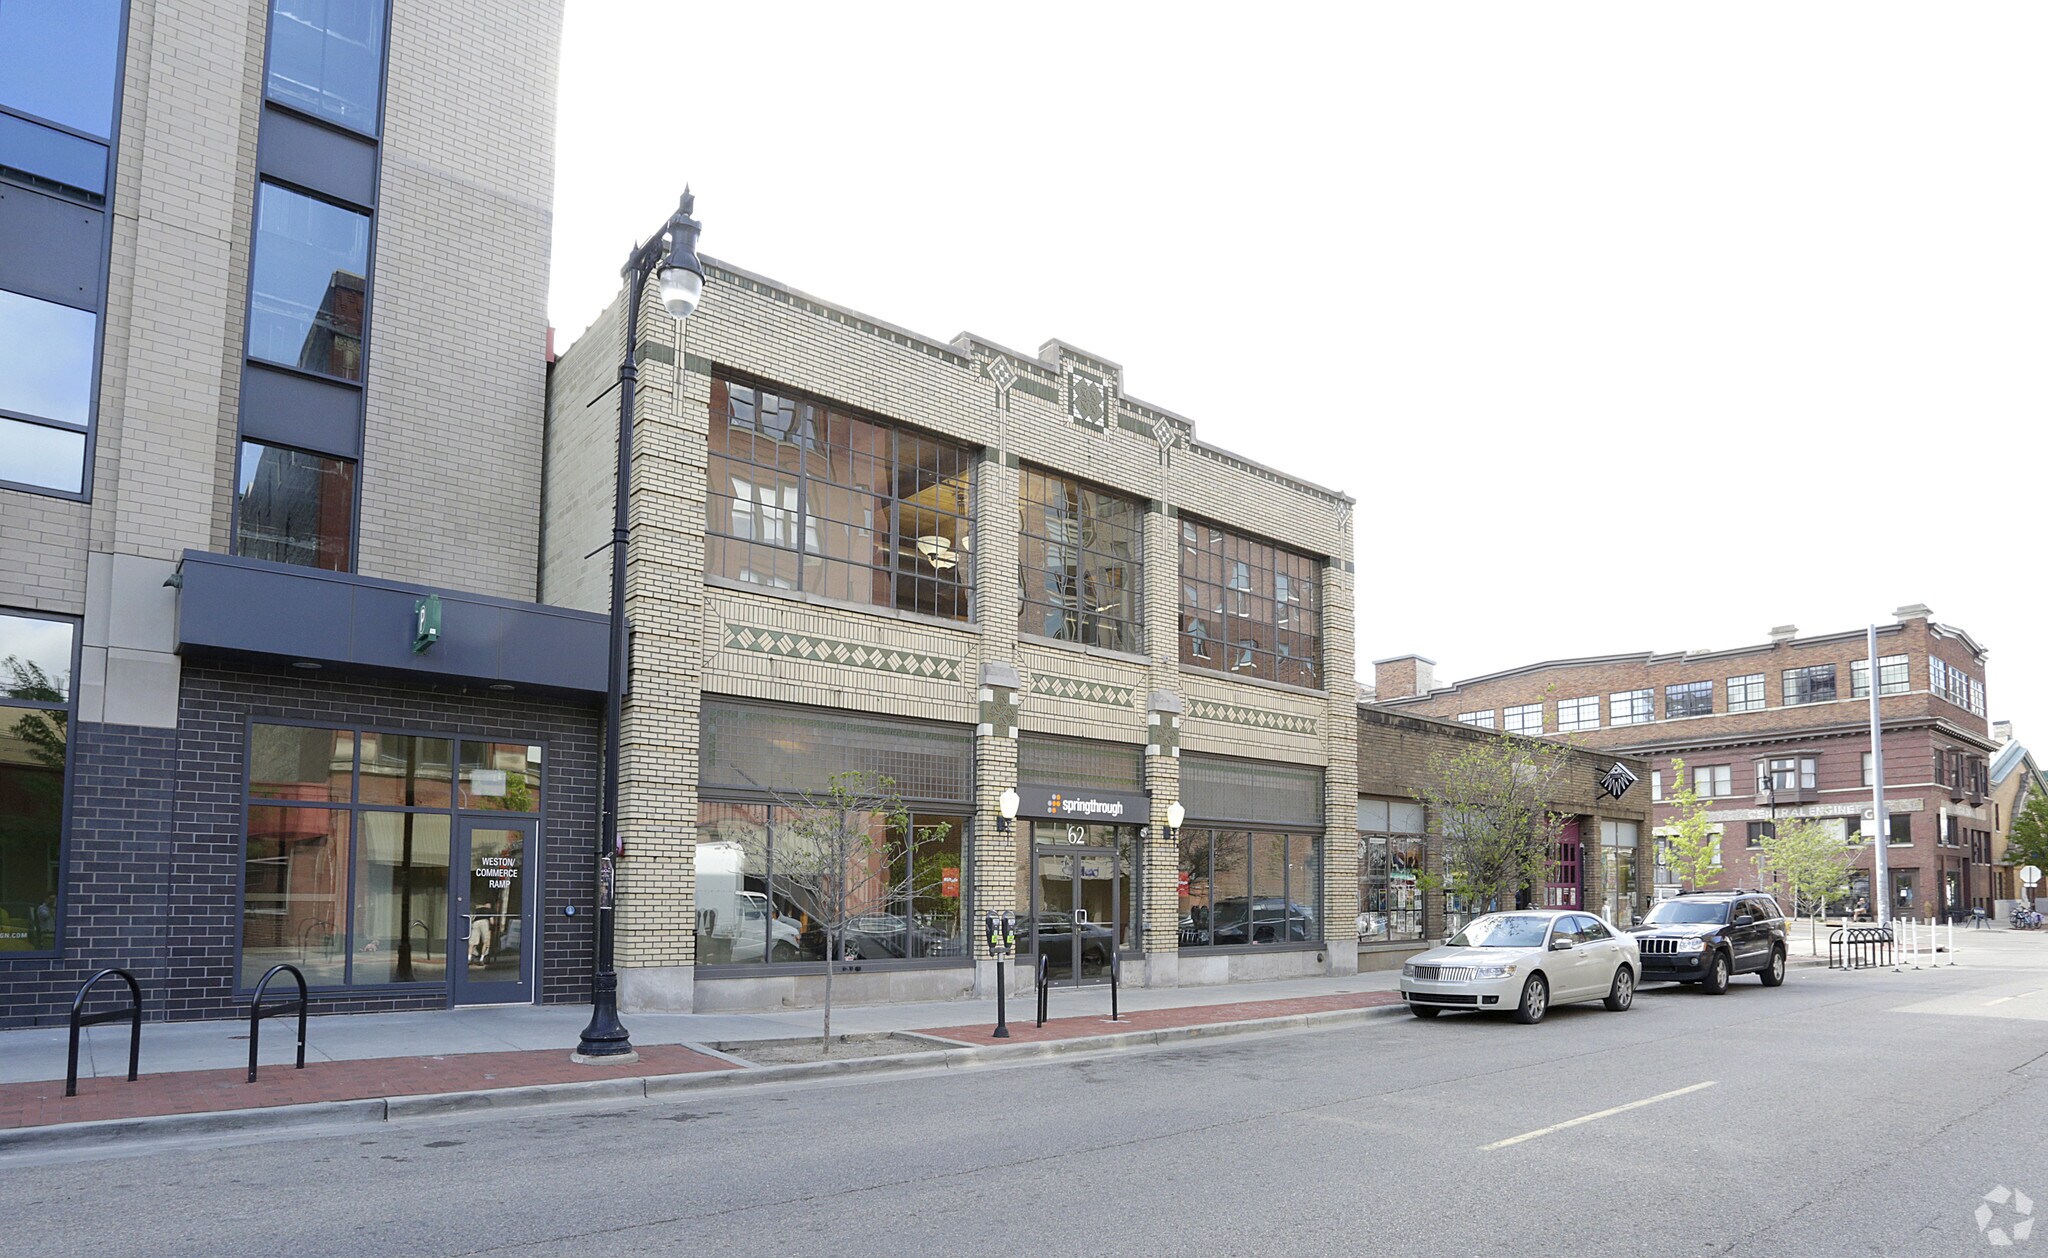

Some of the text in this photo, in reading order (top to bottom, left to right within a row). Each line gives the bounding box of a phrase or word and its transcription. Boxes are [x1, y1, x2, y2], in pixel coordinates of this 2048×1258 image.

[1062, 798, 1123, 817] springthrough
[1068, 826, 1085, 844] 62
[482, 857, 516, 867] WESTON/
[475, 868, 518, 878] COMMERCE
[489, 879, 511, 888] RAMP
